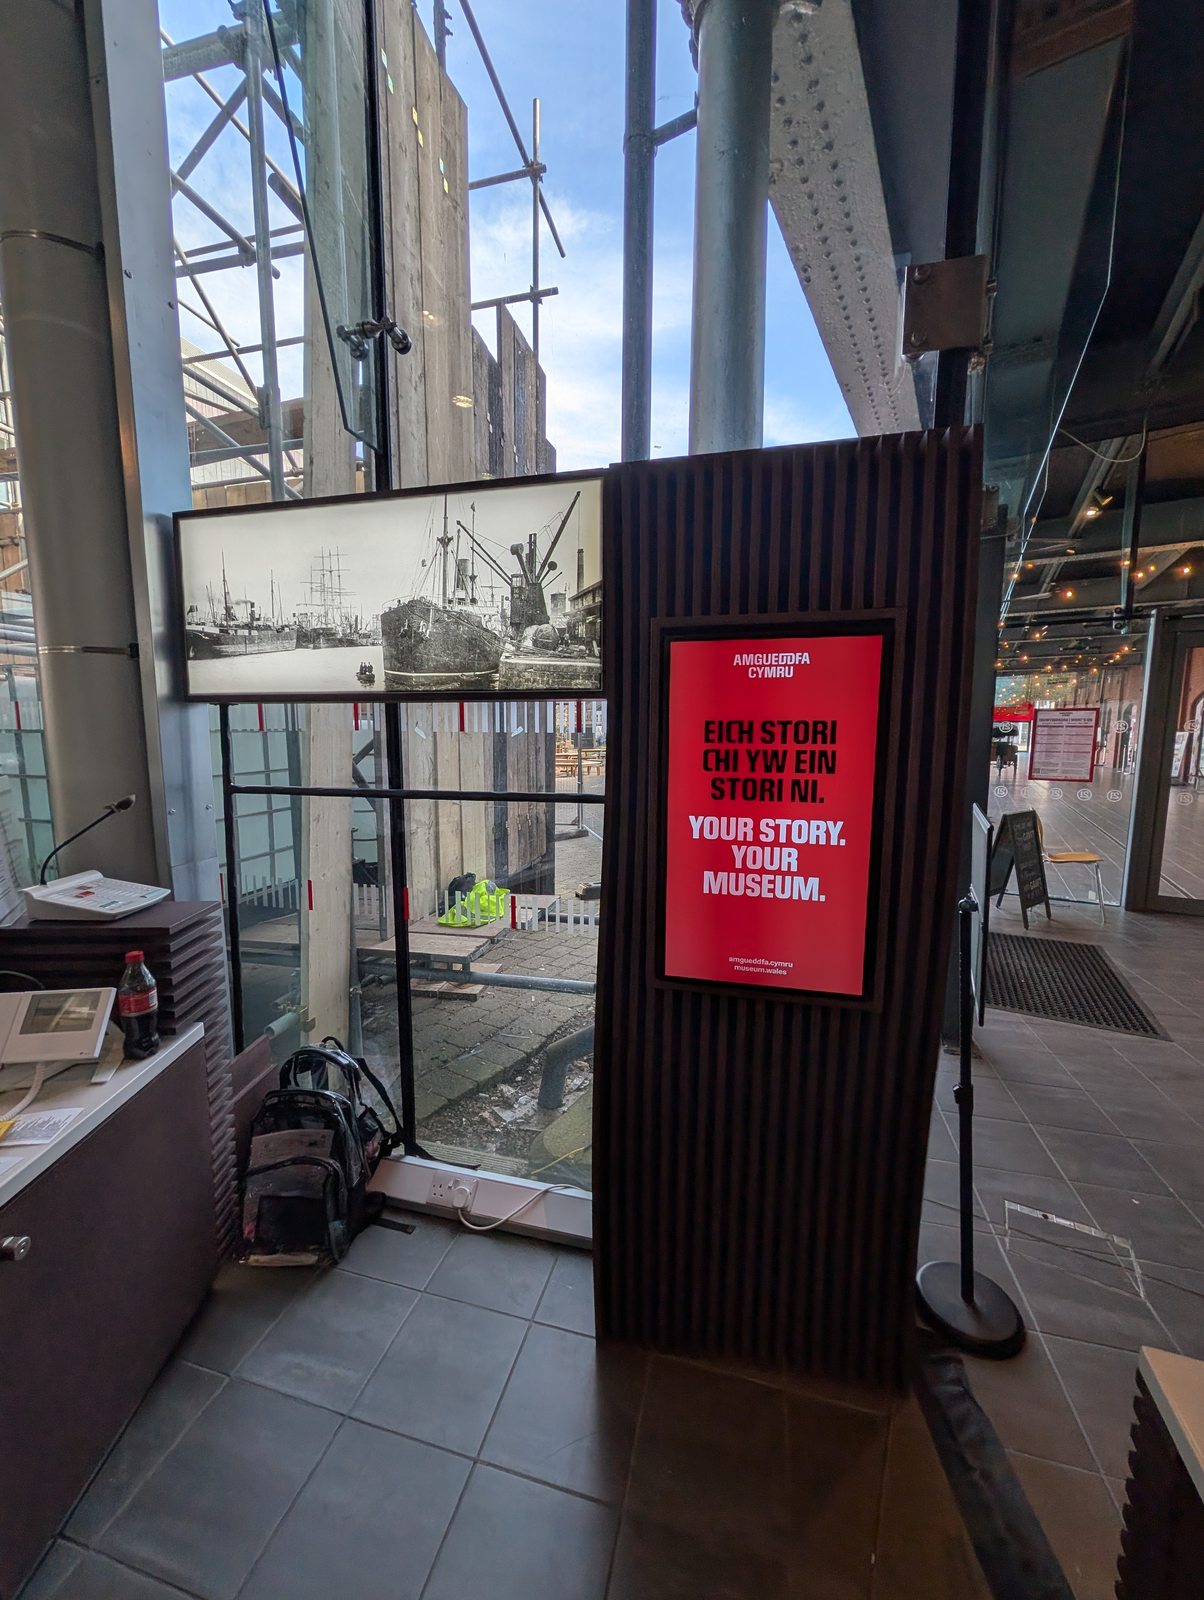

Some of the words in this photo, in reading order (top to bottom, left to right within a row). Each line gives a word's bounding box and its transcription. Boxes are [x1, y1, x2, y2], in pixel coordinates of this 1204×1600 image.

[733, 652, 810, 666] AMGUEDDFA
[748, 666, 794, 678] CYMRU
[704, 720, 754, 743] EICH
[760, 720, 837, 744] STORI
[703, 749, 739, 772] CHI
[745, 749, 788, 773] YW
[794, 750, 837, 774] EIN
[711, 777, 783, 802] STORI
[790, 779, 825, 803] NI.
[689, 815, 754, 842] YOUR
[759, 818, 846, 846] STORY.
[731, 845, 798, 872] YOUR
[703, 871, 826, 902] MUSEUM.
[728, 956, 794, 968] amgueddfa.cymru
[734, 965, 787, 975] museum.wales
